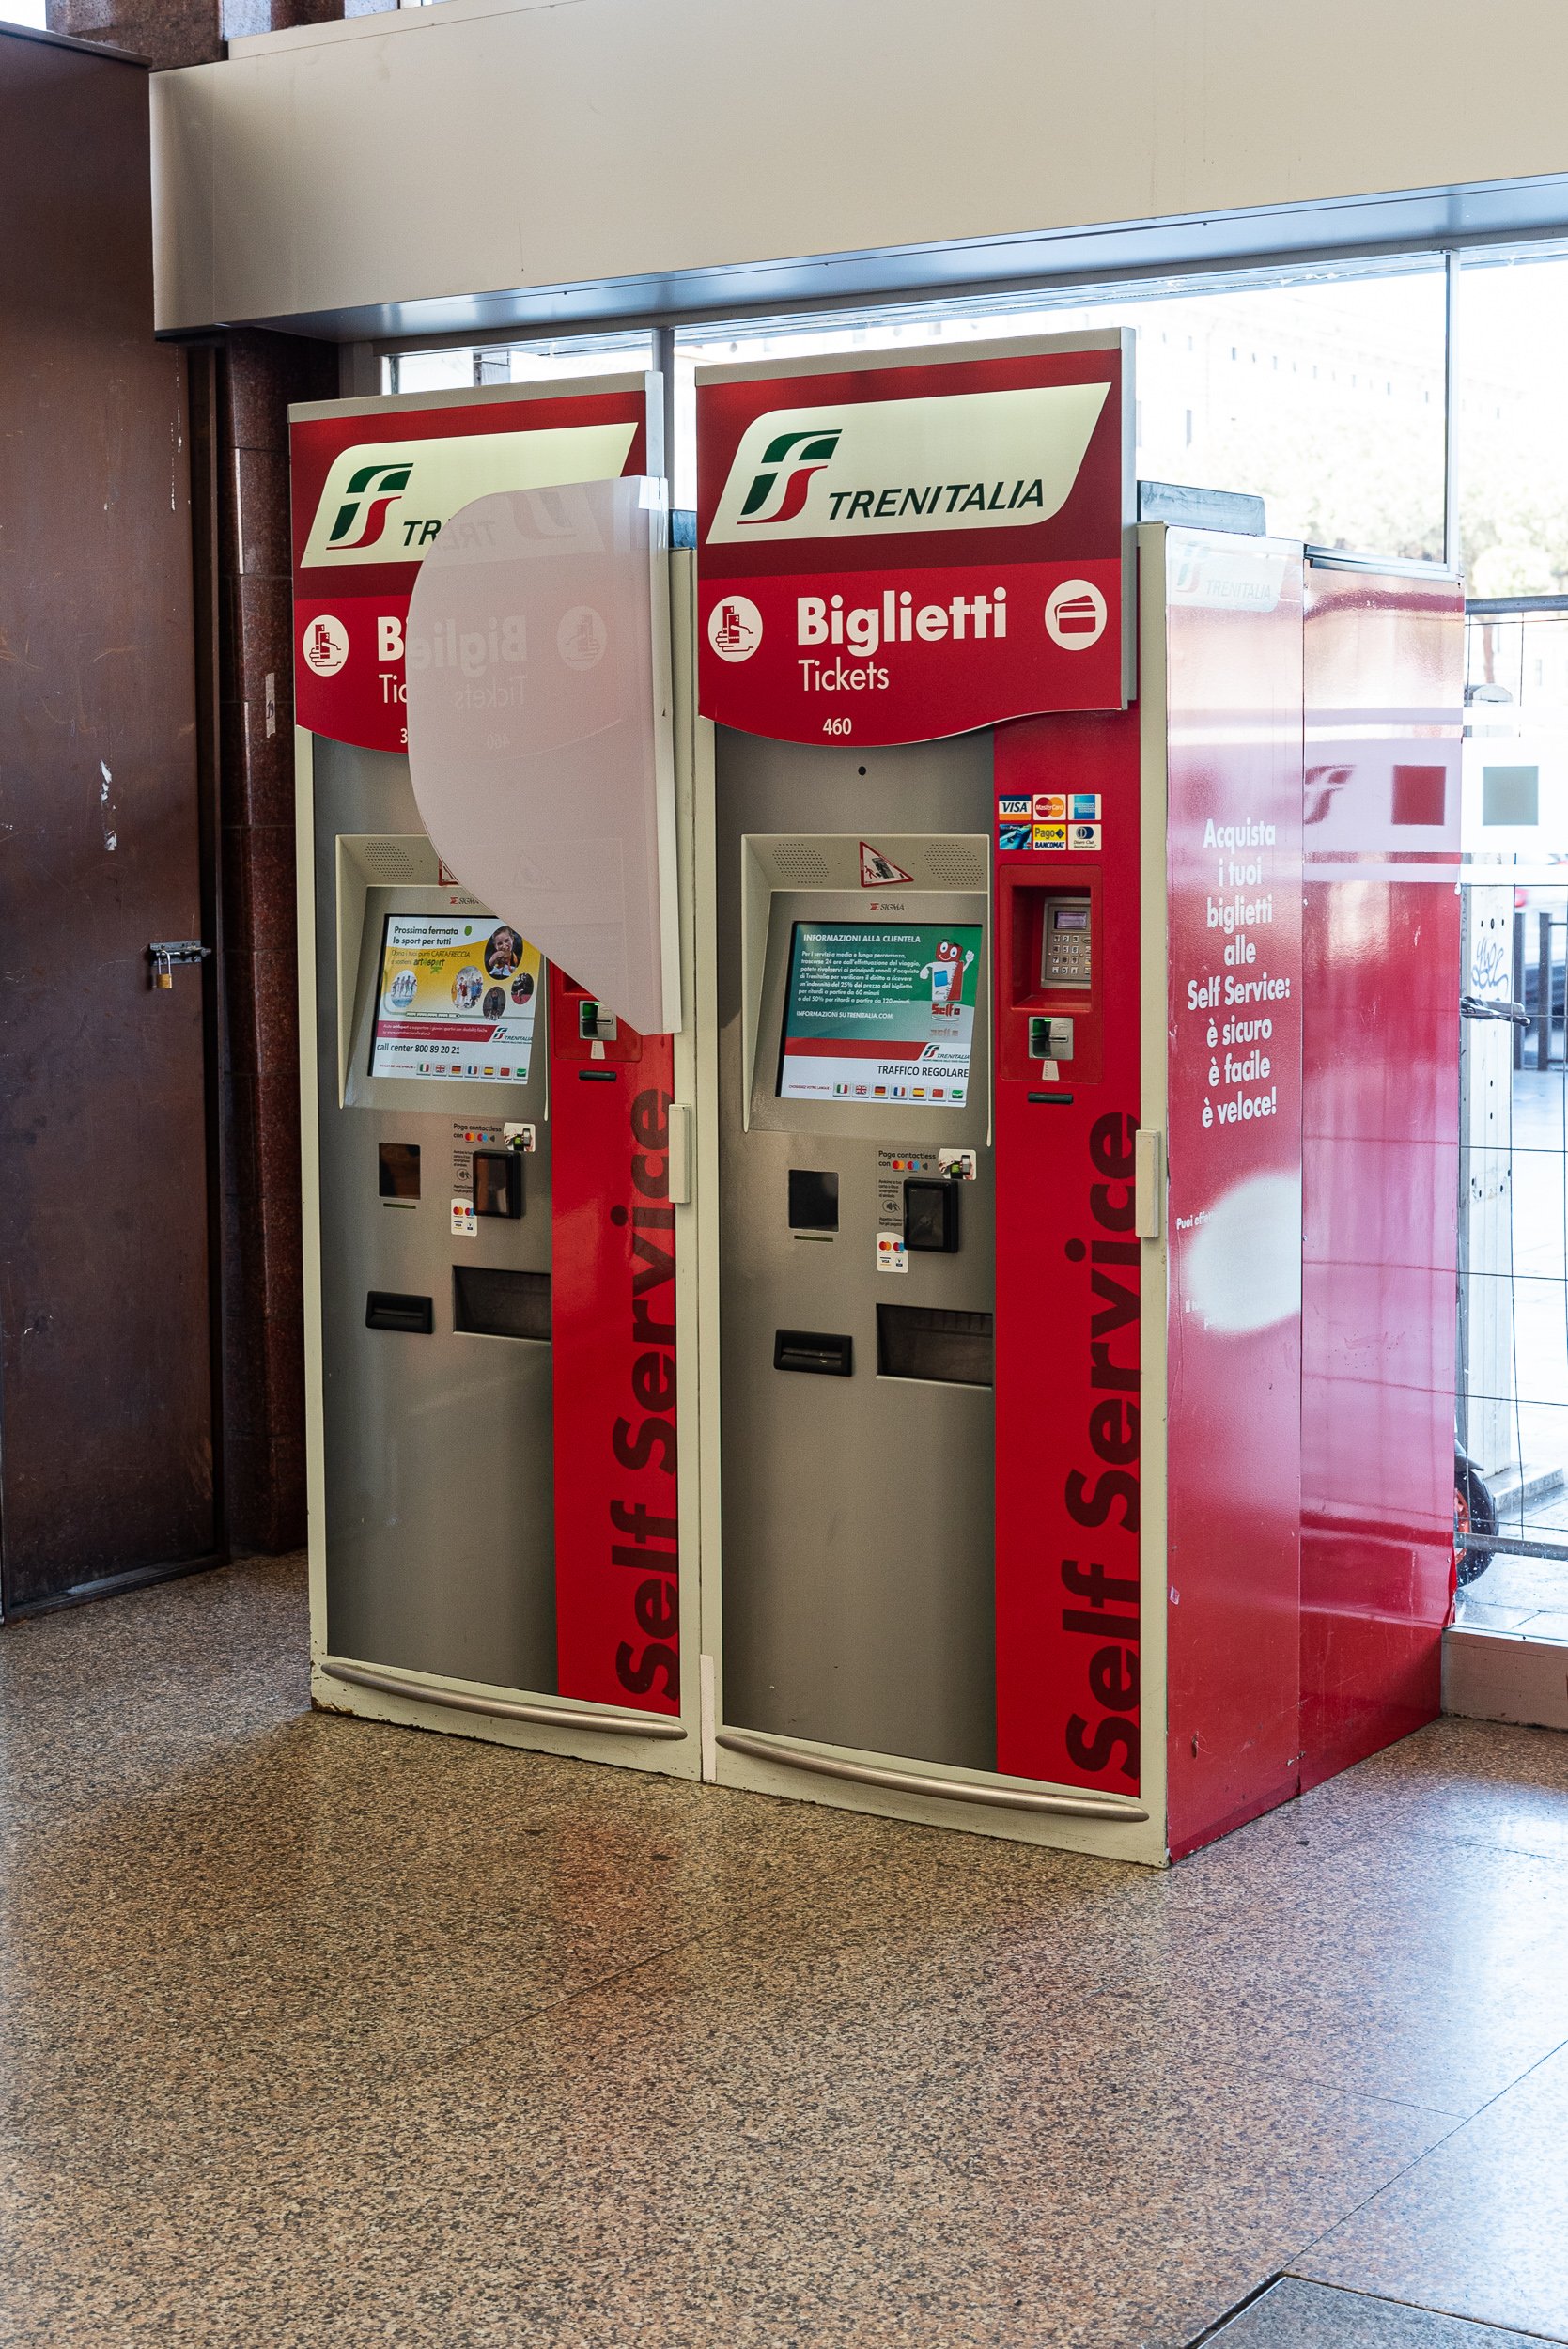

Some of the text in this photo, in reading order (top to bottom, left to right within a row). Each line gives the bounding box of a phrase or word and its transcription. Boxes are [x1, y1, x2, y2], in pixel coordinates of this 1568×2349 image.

[828, 479, 1044, 521] TRENITALIA
[1205, 579, 1271, 600] TRENITALIA
[797, 586, 1006, 657] Biglietti
[798, 657, 889, 692] Tickets
[822, 717, 852, 736] 460
[1002, 801, 1028, 813] VISA
[1034, 828, 1055, 839] Pago
[1203, 818, 1276, 848] Acquista
[1218, 857, 1262, 887] i tuoi
[1207, 894, 1272, 934] biglietti
[803, 934, 861, 942] INFORMAZIONI
[1224, 934, 1256, 966] alle
[1188, 972, 1291, 1012] Self Service:
[377, 1043, 389, 1051] call
[415, 1045, 428, 1053] 800
[1207, 1018, 1272, 1048] è sicuro
[877, 1066, 969, 1077] TRAFFICO REGOLARE
[1208, 1053, 1270, 1087] è facile
[1202, 1097, 1276, 1128] è veloce!
[878, 1150, 895, 1159] Paga
[1176, 1215, 1193, 1230] Puoi
[611, 1089, 680, 1703] Self Service
[1062, 1112, 1140, 1781] Self Service
